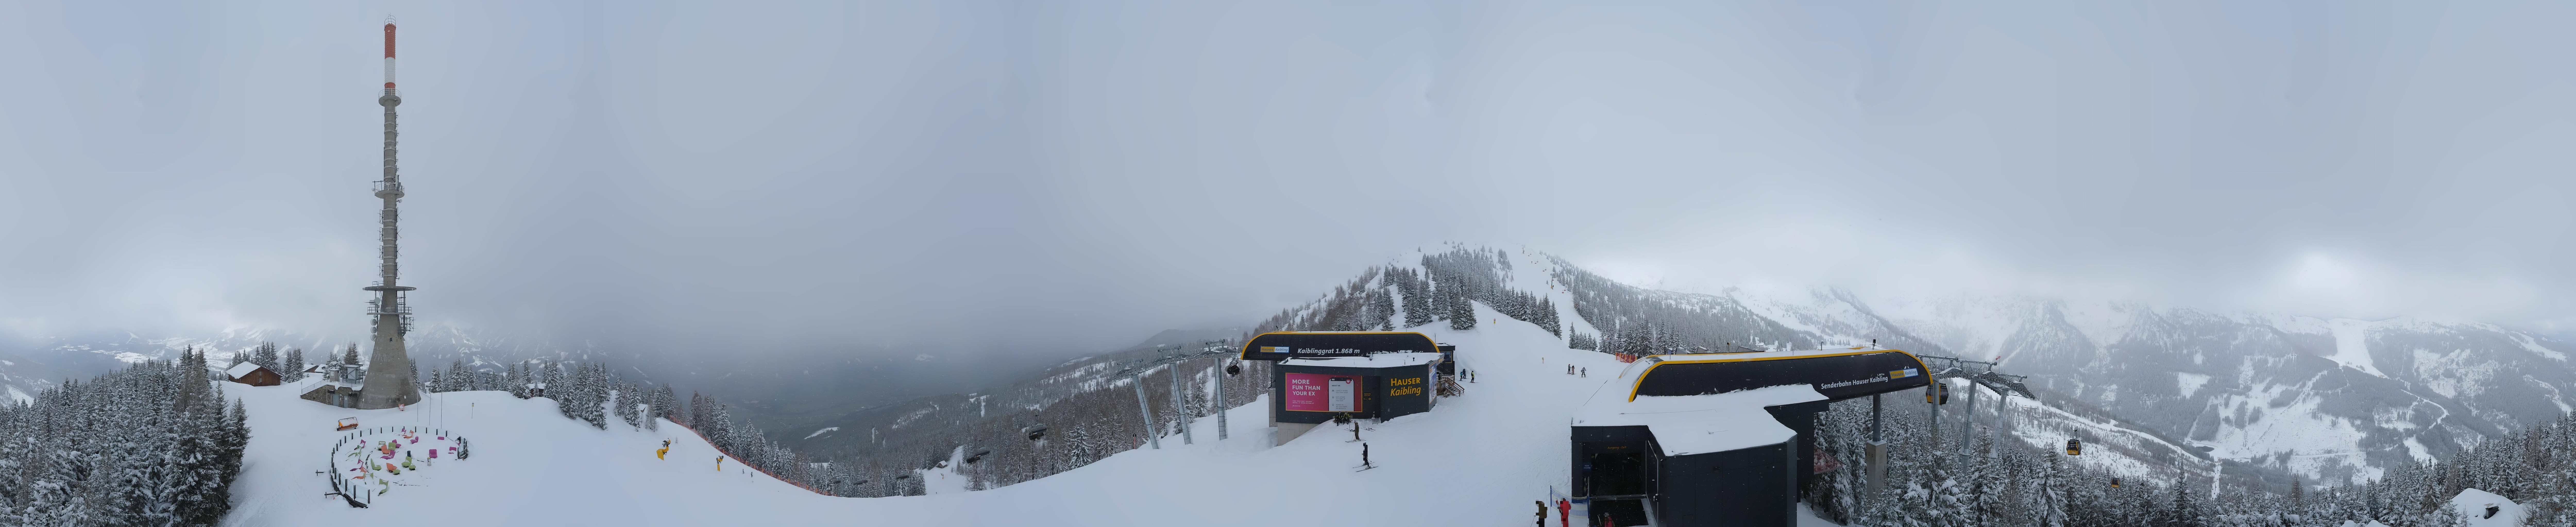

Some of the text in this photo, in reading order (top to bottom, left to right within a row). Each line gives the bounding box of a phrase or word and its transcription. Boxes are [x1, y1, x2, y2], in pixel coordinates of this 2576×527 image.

[1391, 378, 1420, 386] HAUSER
[1821, 380, 1851, 389] Senderbahn
[1390, 386, 1421, 396] Kaibling
